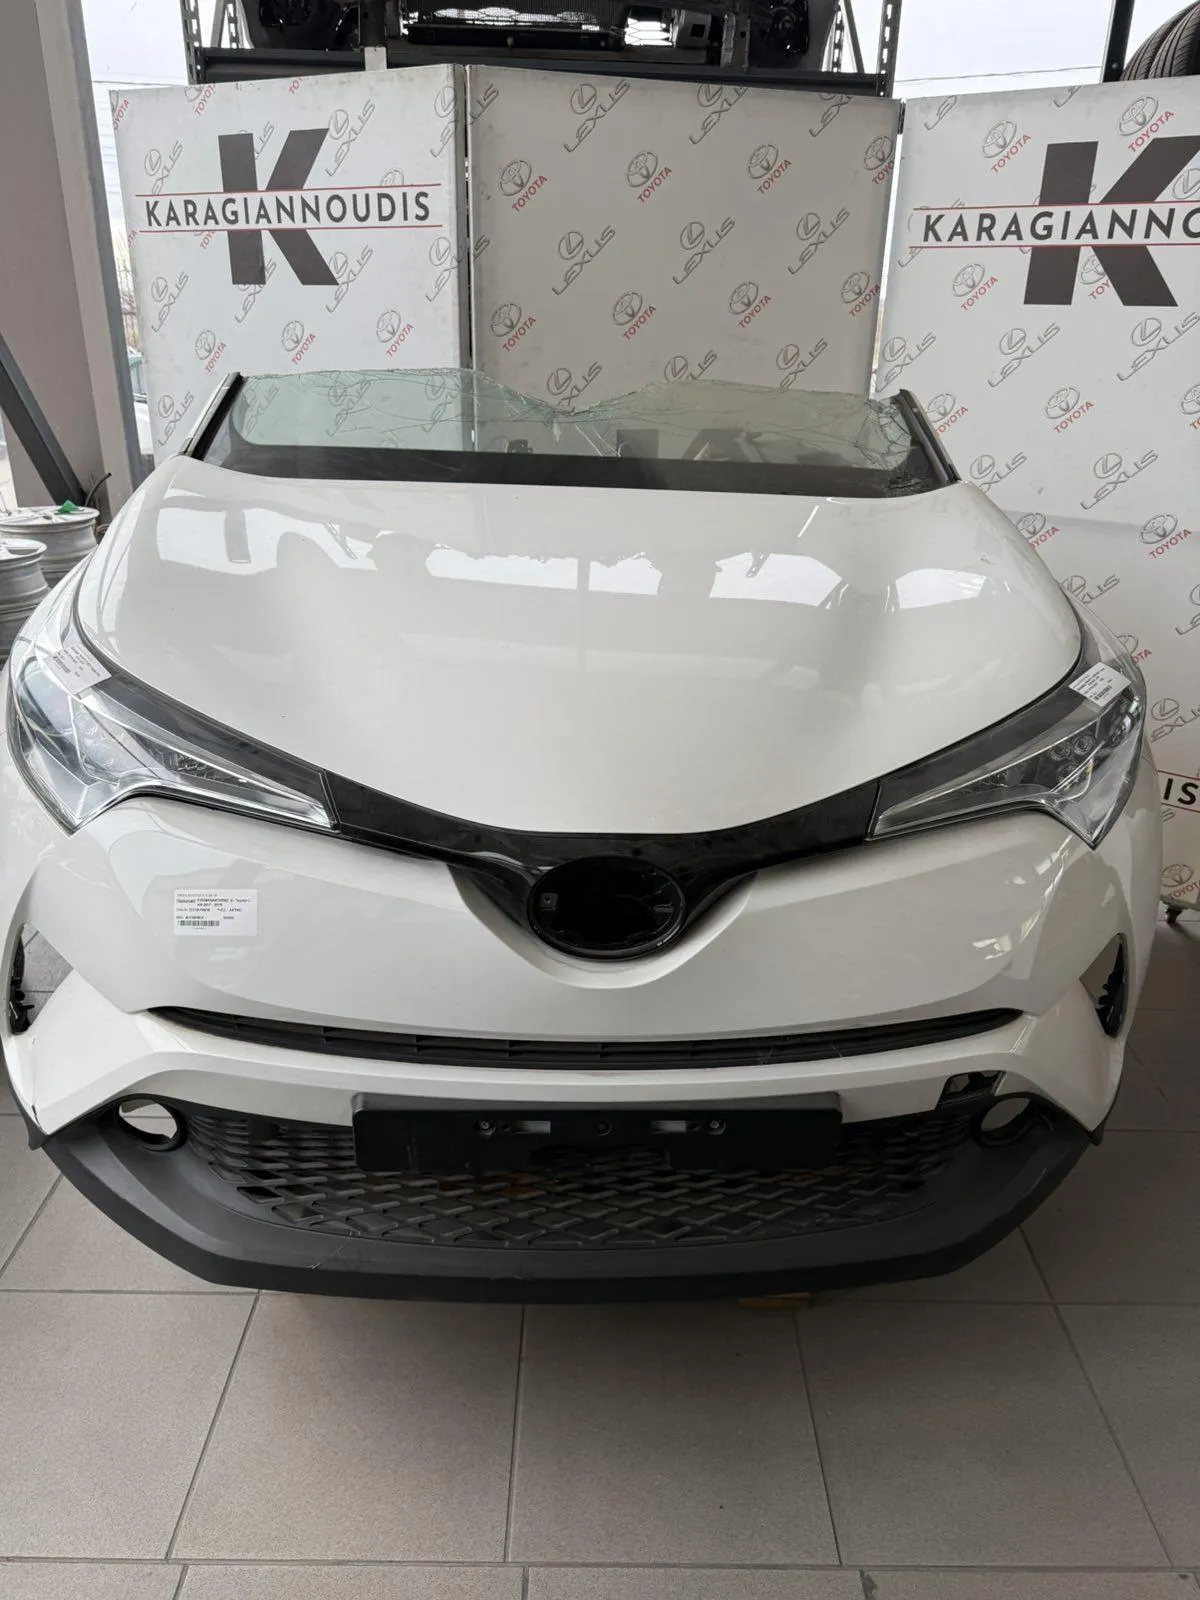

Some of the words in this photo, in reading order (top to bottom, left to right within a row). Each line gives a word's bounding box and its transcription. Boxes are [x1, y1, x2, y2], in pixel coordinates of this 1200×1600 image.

[113, 100, 130, 130] OYOTA
[195, 84, 216, 116] TOYOT
[563, 78, 631, 153] LEXUS
[689, 87, 748, 145] LEXU
[325, 99, 376, 177] LEXUS
[1127, 110, 1175, 154] TOYOTA
[152, 140, 183, 195] EXUS
[991, 134, 1031, 173] TOYOTA
[637, 166, 673, 204] TOYOTA
[756, 159, 792, 196] TOYOTA
[871, 160, 894, 186] TOYO
[145, 191, 430, 227] KARAGIANNOUDIS
[511, 174, 547, 212] TOYOTA
[552, 224, 616, 295] LEXUS
[672, 217, 735, 285] LEXUS
[788, 207, 851, 275] LEXUS
[151, 271, 189, 332] LEXUS
[738, 295, 772, 329] TOYOTA
[848, 283, 881, 318] TOYOTA
[960, 276, 999, 312] TOYOTA
[386, 323, 414, 358] TOYOTA
[502, 316, 536, 353] TOYOTA
[622, 304, 656, 341] TOYOTA
[205, 342, 227, 374] TOYOTA
[291, 333, 317, 366] TOYOTA
[988, 322, 1060, 388] LEXUS
[1053, 400, 1094, 434] TOYOTA
[1080, 450, 1159, 511] LEXUS
[1149, 528, 1192, 560] TOYOTA
